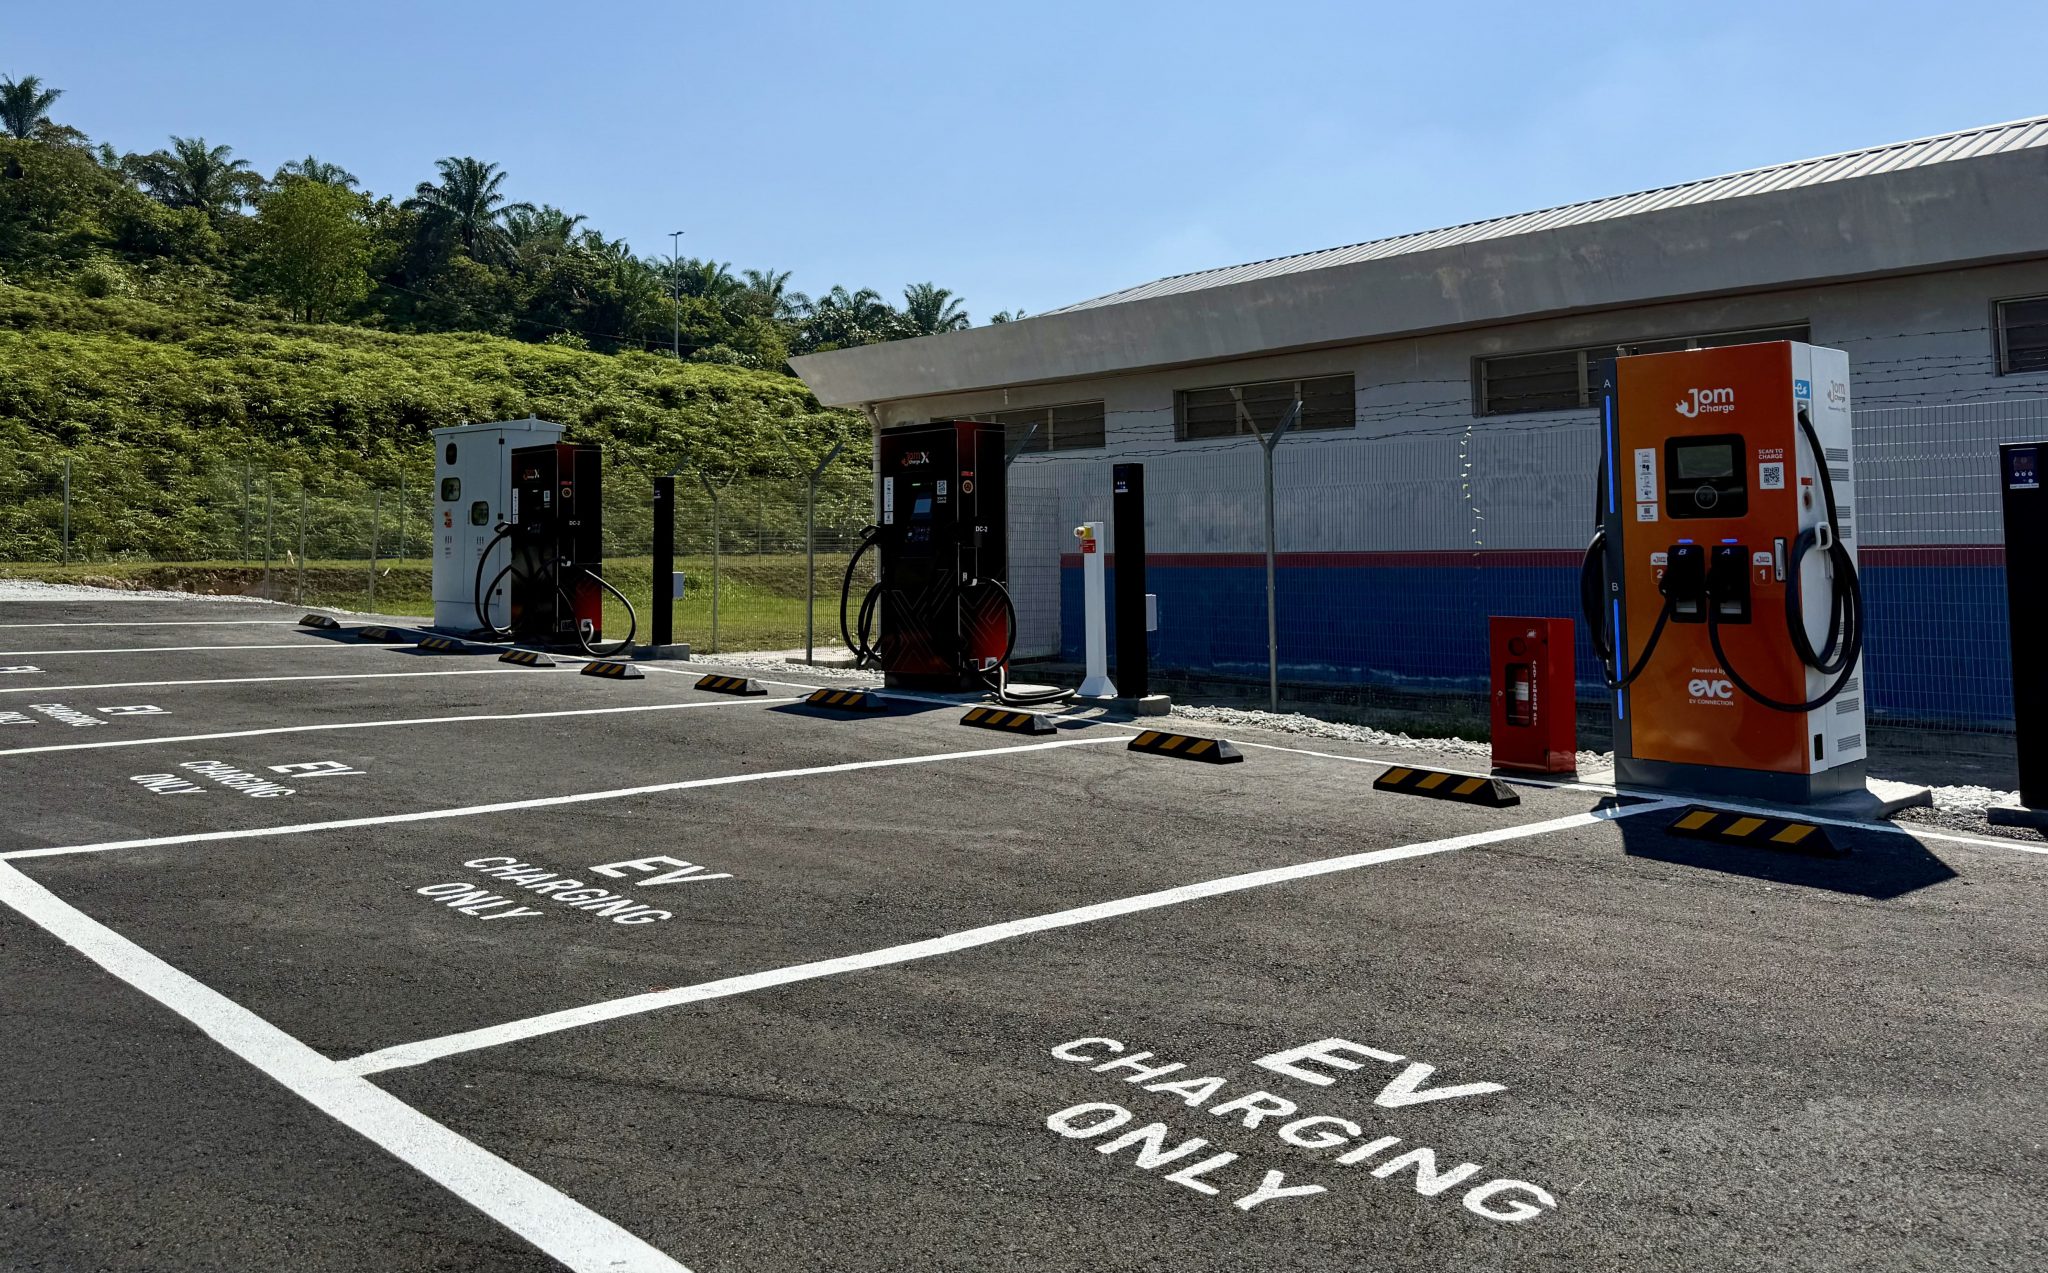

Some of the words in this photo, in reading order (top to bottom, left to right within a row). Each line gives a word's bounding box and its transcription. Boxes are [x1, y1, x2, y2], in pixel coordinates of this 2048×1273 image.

[1603, 379, 1612, 390] A
[1679, 387, 1734, 418] Jom
[1699, 404, 1735, 414] Charge
[1678, 548, 1688, 556] B
[1721, 548, 1731, 556] A
[1656, 568, 1664, 579] 2
[1759, 569, 1766, 580] 1
[1611, 582, 1619, 592] B
[179, 760, 296, 798] CHARGING
[267, 760, 367, 778] EV
[129, 773, 208, 795] ONLY
[588, 855, 734, 887] EV
[416, 882, 545, 921] ONLY
[463, 856, 673, 925] CHARGING
[1251, 1037, 1510, 1109] EV
[1051, 1036, 1558, 1222] CHARGING
[1046, 1102, 1328, 1212] ONLY
